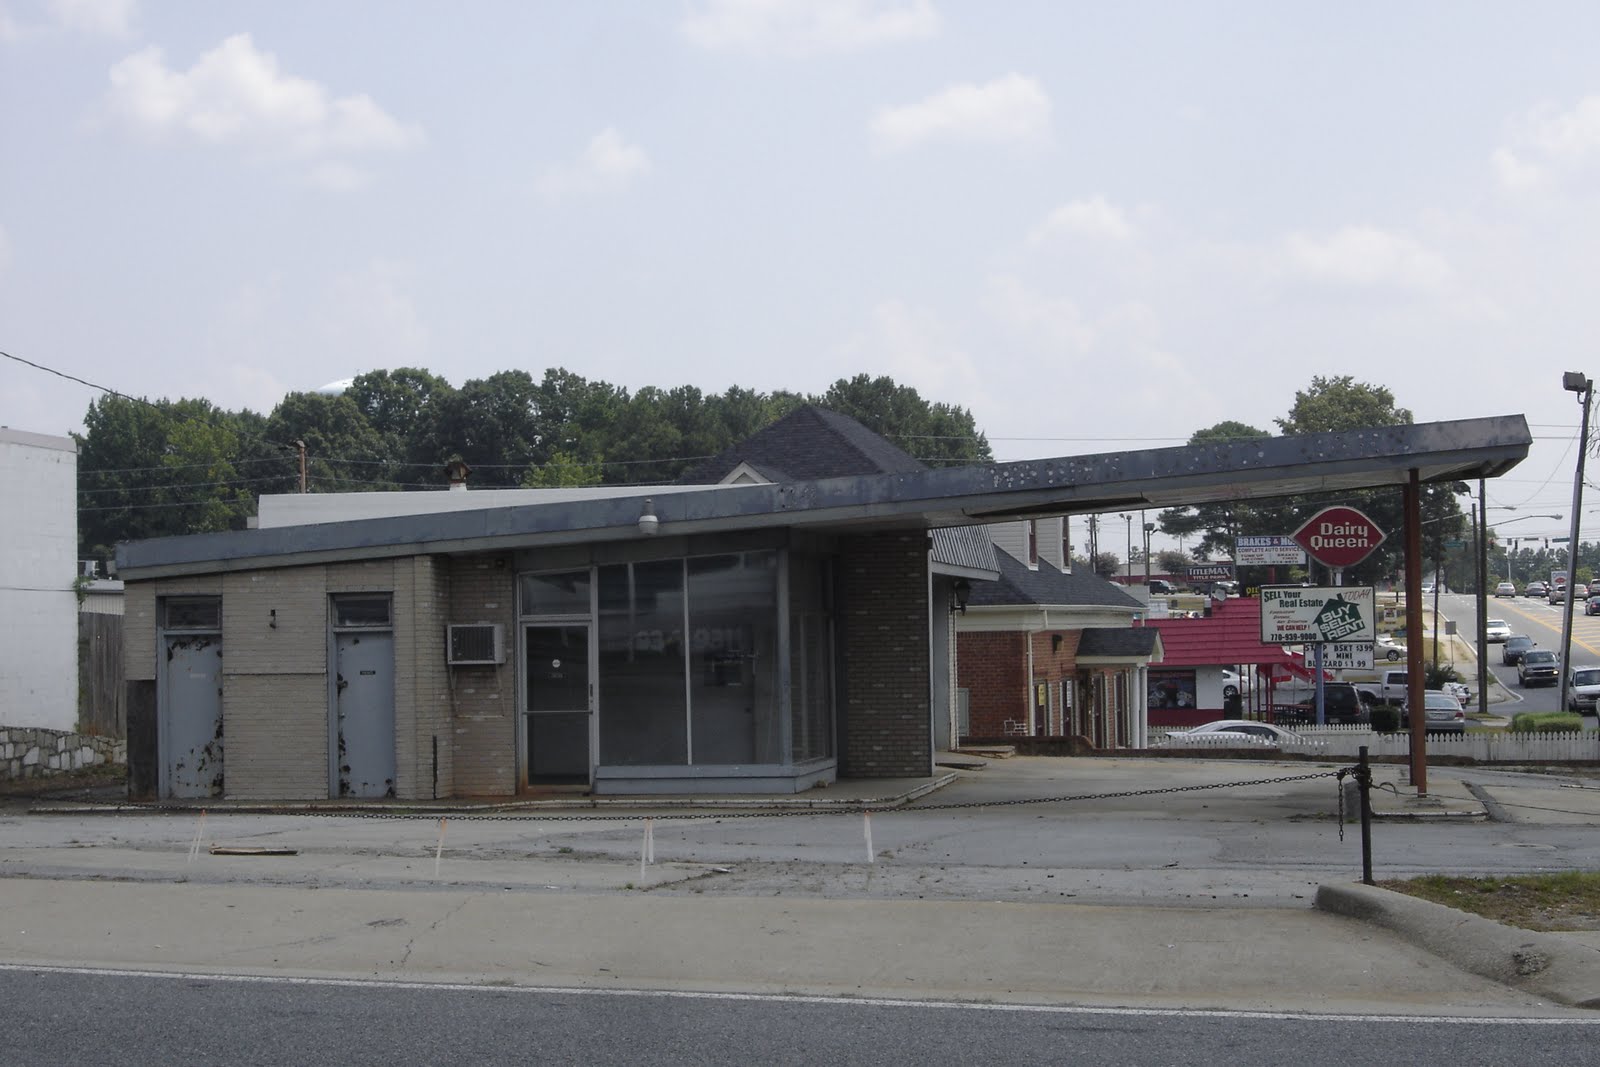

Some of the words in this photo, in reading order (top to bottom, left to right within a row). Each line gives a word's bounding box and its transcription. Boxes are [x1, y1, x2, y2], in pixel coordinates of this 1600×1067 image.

[1320, 522, 1368, 537] Dairy
[1238, 538, 1271, 546] BRAKES
[1310, 535, 1368, 550] Queen
[1264, 591, 1282, 602] SELL
[1284, 591, 1301, 599] Your
[1343, 589, 1371, 600] TODAY
[1280, 600, 1297, 608] Real
[1300, 600, 1323, 608] Estate
[1321, 604, 1351, 623] BUY
[1326, 620, 1363, 640] RENT
[1271, 633, 1317, 641] 770-939-9000
[1334, 644, 1353, 652] BSKT
